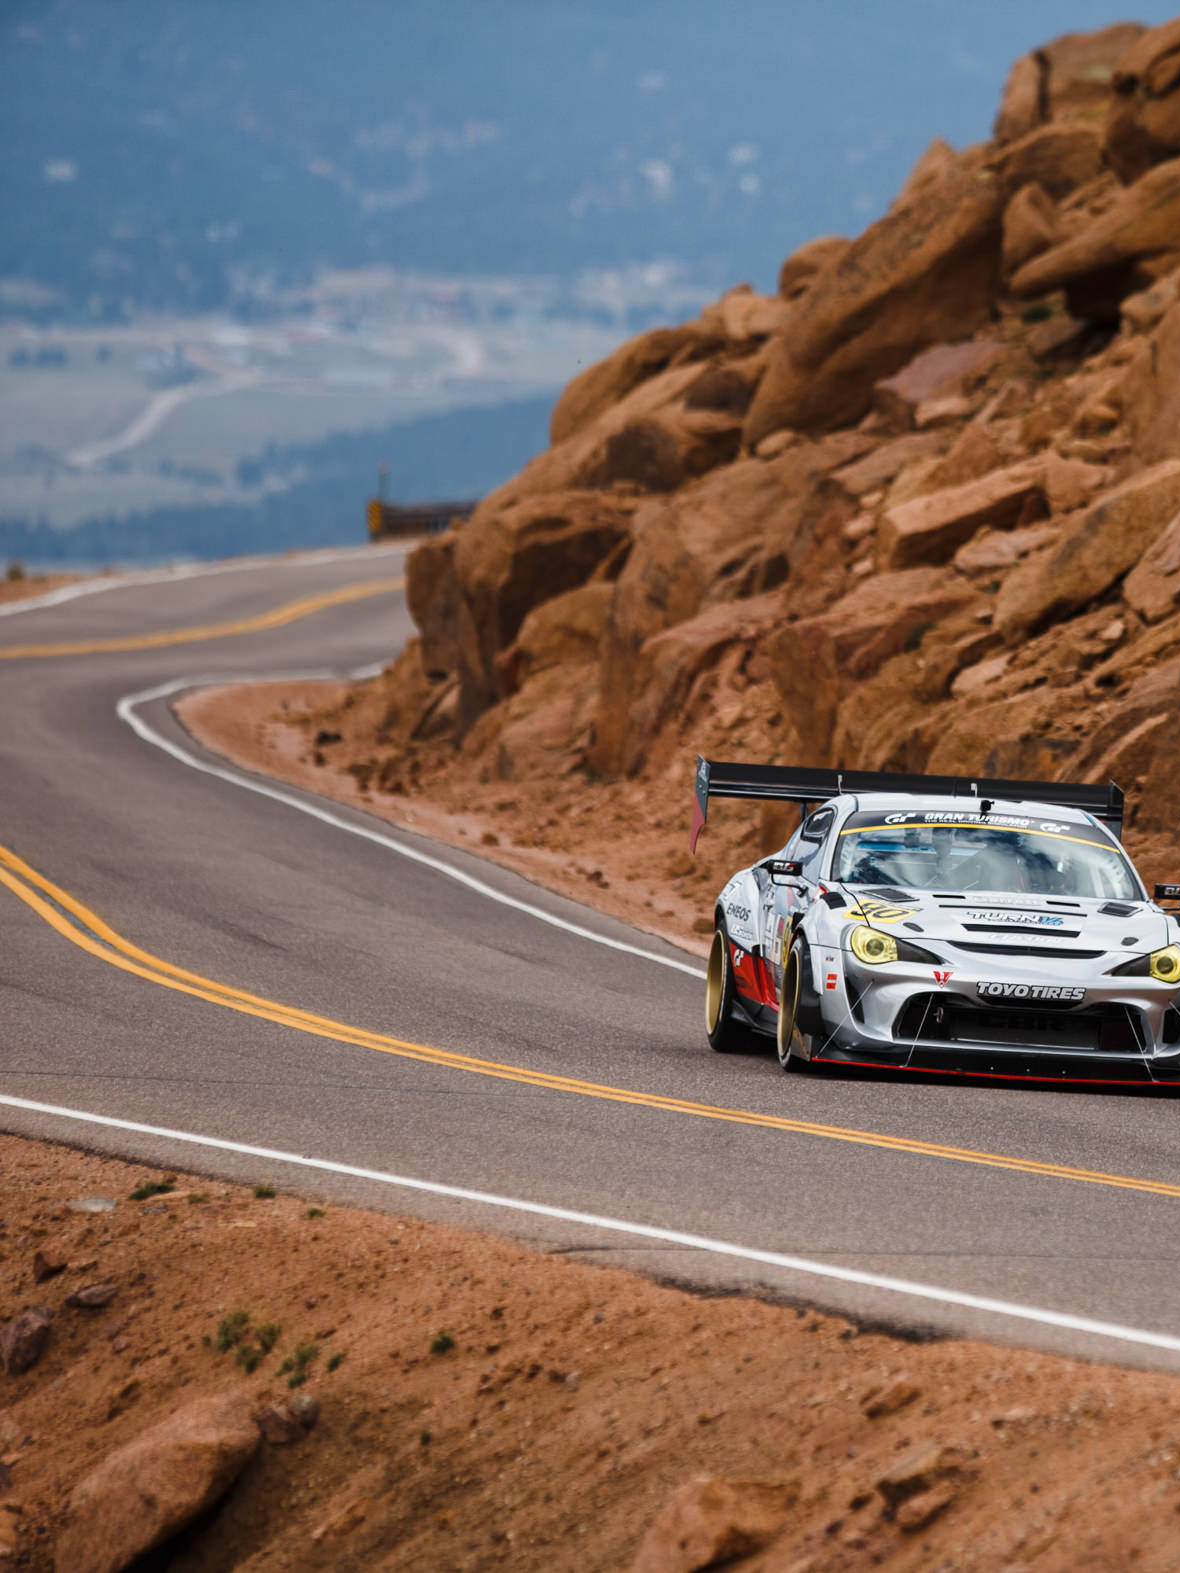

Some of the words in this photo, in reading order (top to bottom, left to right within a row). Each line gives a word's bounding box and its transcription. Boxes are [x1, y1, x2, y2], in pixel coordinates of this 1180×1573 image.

[924, 812, 964, 820] GRAN
[967, 814, 1030, 826] TURISMO
[726, 903, 752, 922] ENEOS
[850, 902, 911, 919] 90
[977, 982, 1029, 998] TOYO
[1031, 986, 1085, 1000] TIRES
